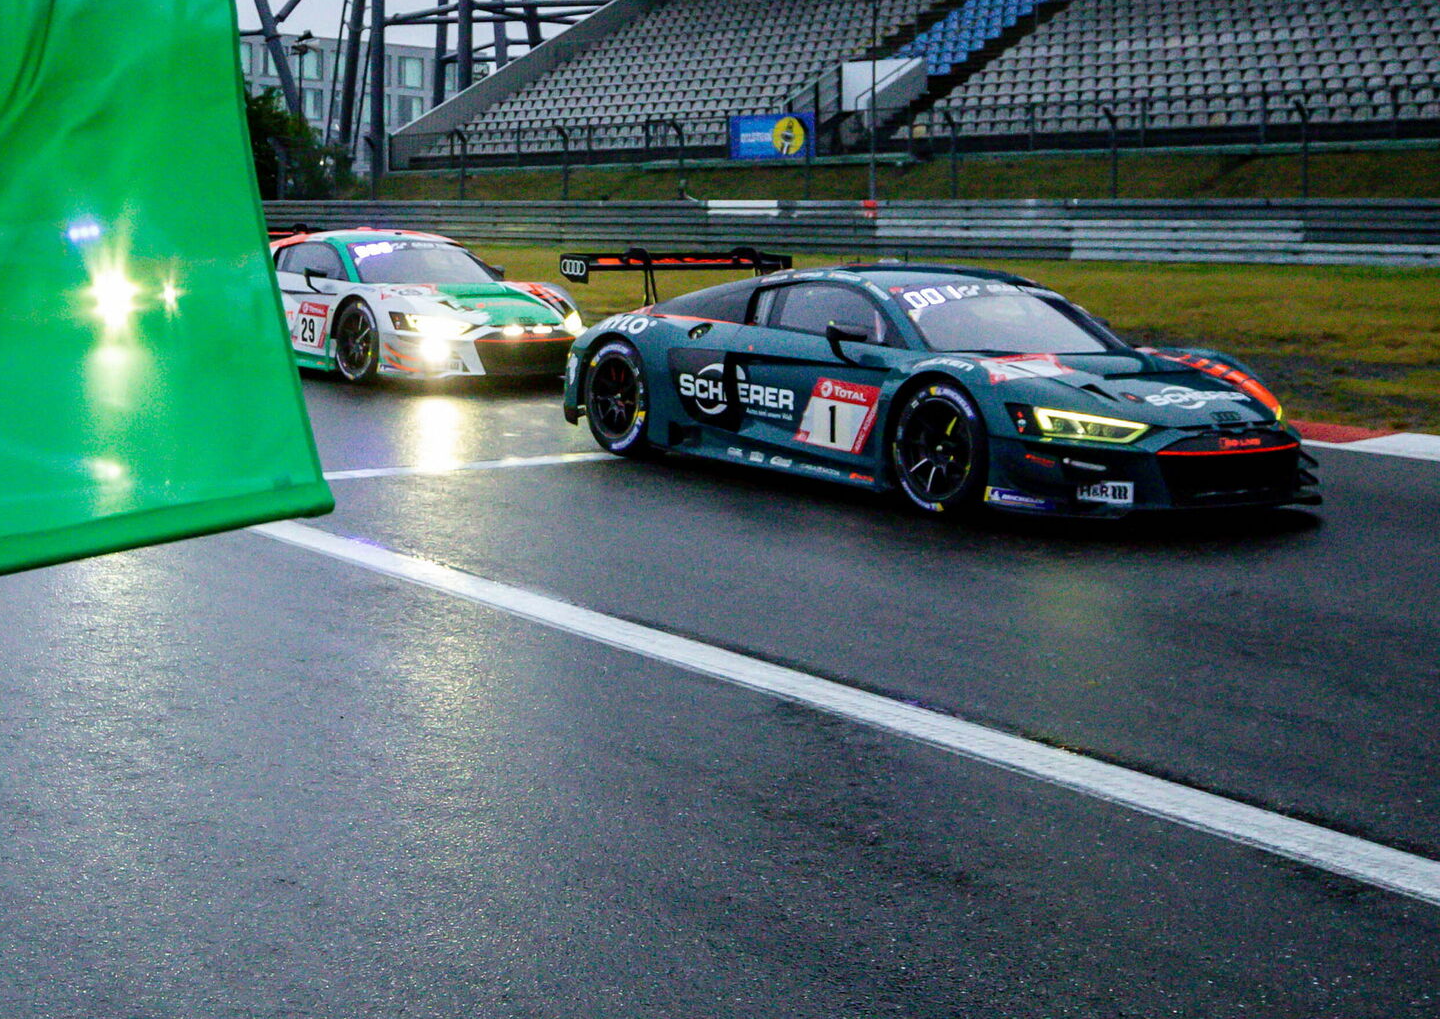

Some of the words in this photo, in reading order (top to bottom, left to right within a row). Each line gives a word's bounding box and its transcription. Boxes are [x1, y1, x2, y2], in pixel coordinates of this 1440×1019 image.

[301, 318, 315, 342] 29
[834, 385, 867, 402] TOTAL
[828, 405, 837, 444] 1
